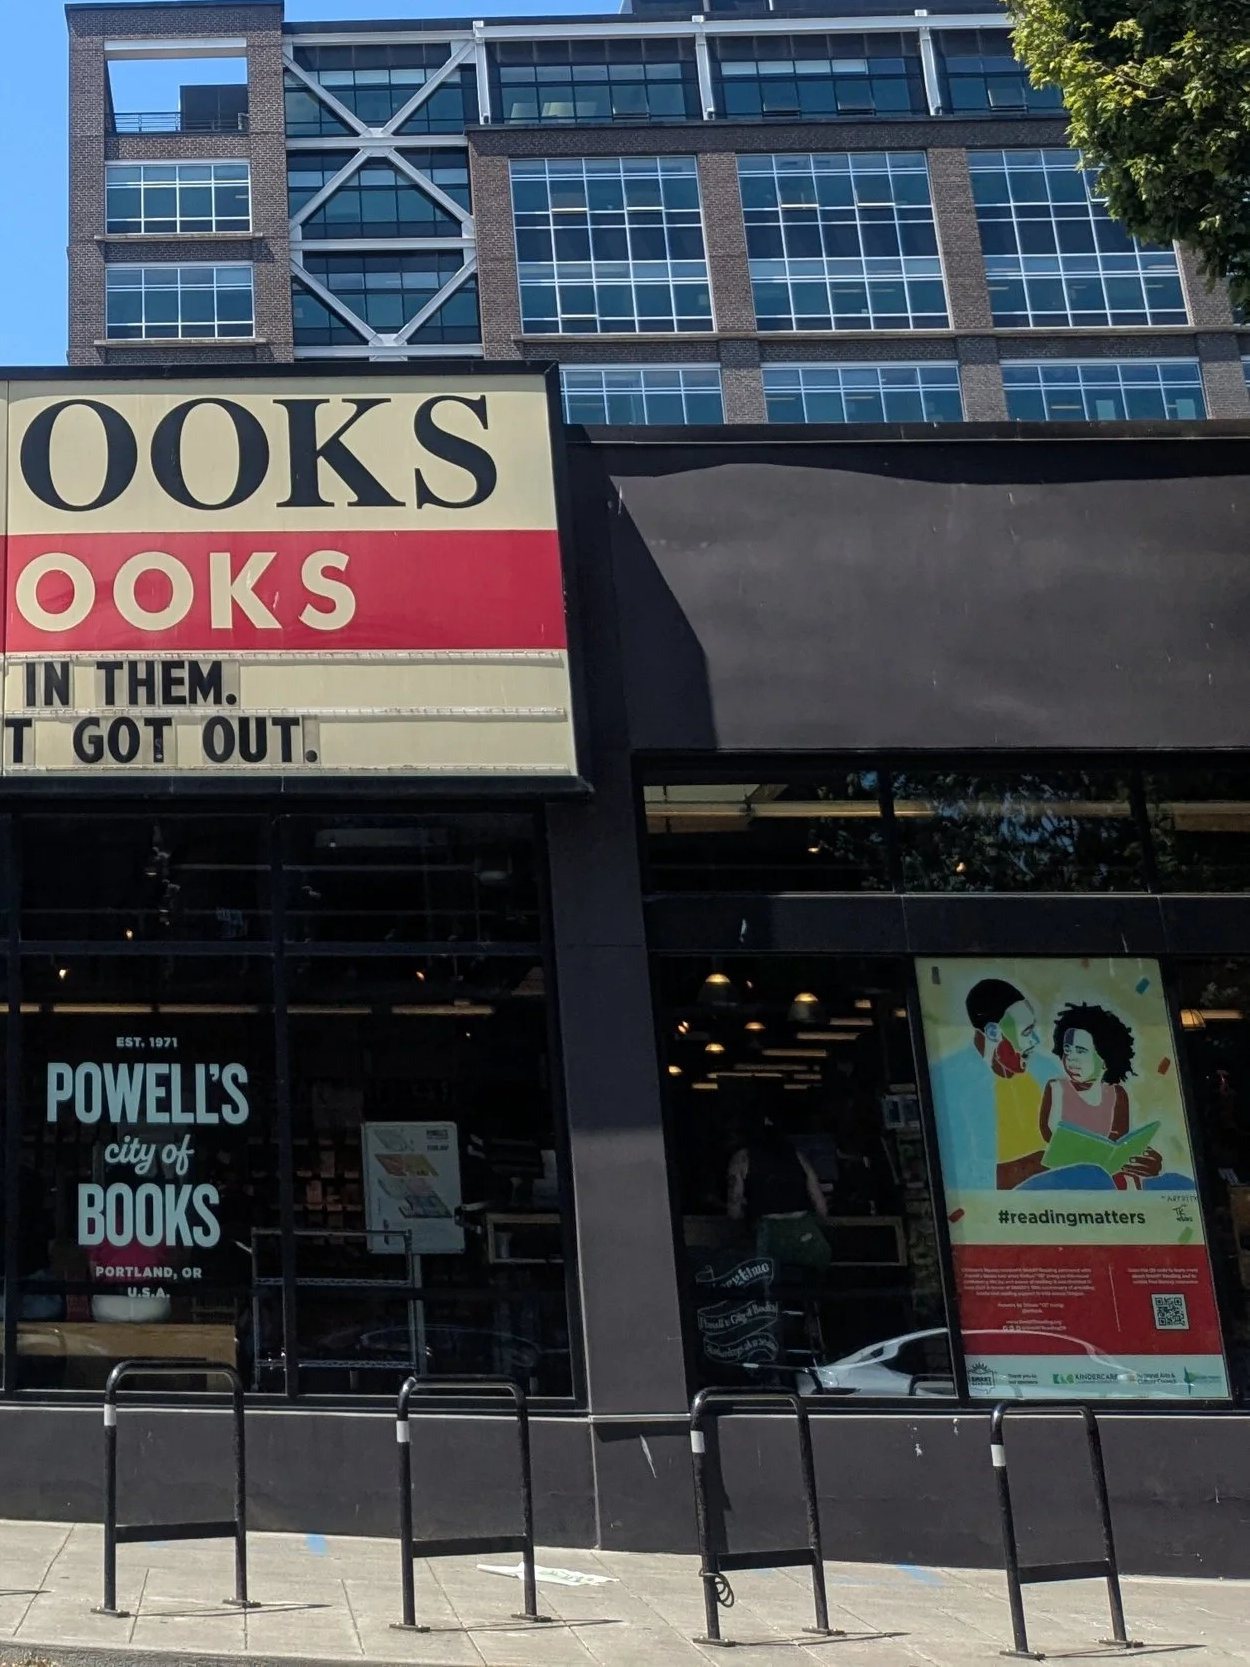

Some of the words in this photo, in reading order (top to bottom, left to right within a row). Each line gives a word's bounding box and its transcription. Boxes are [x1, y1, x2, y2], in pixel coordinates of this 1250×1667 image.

[25, 661, 71, 707] IN
[96, 660, 238, 706] THEM.
[73, 716, 173, 765] GOT
[202, 715, 319, 764] OUT.
[116, 1037, 145, 1048] EST.
[149, 1037, 179, 1048] 1971
[47, 1062, 249, 1124] POWELL'S
[104, 1135, 156, 1175] city
[161, 1134, 195, 1176] of
[78, 1182, 221, 1248] BOOKS
[998, 1209, 1146, 1227] #readingmatters
[95, 1266, 178, 1279] PORTLAND,
[182, 1267, 203, 1278] OR
[127, 1287, 171, 1299] U.S.A.
